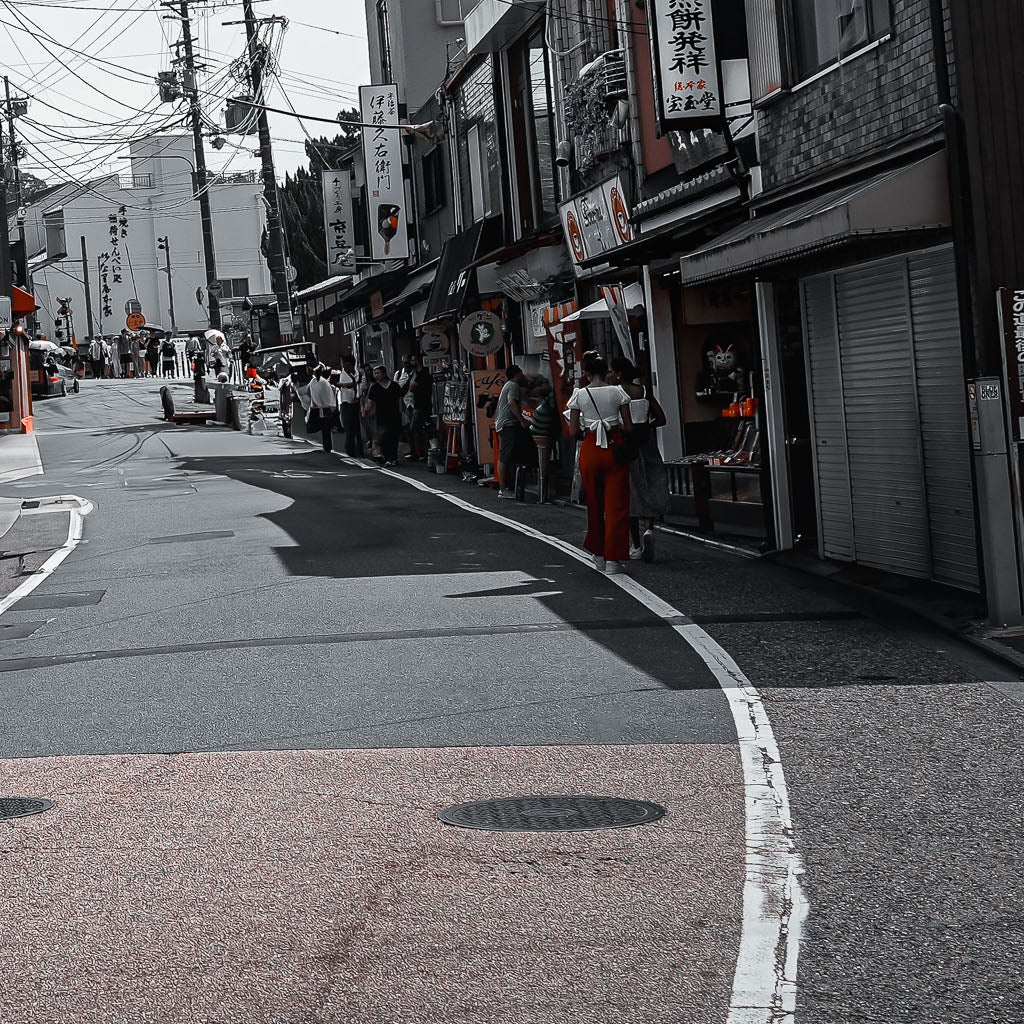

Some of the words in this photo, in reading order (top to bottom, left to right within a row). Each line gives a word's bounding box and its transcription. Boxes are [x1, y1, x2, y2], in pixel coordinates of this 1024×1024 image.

[666, 91, 716, 113] 宝玉堂
[370, 95, 392, 190] 伊藤久右衛門
